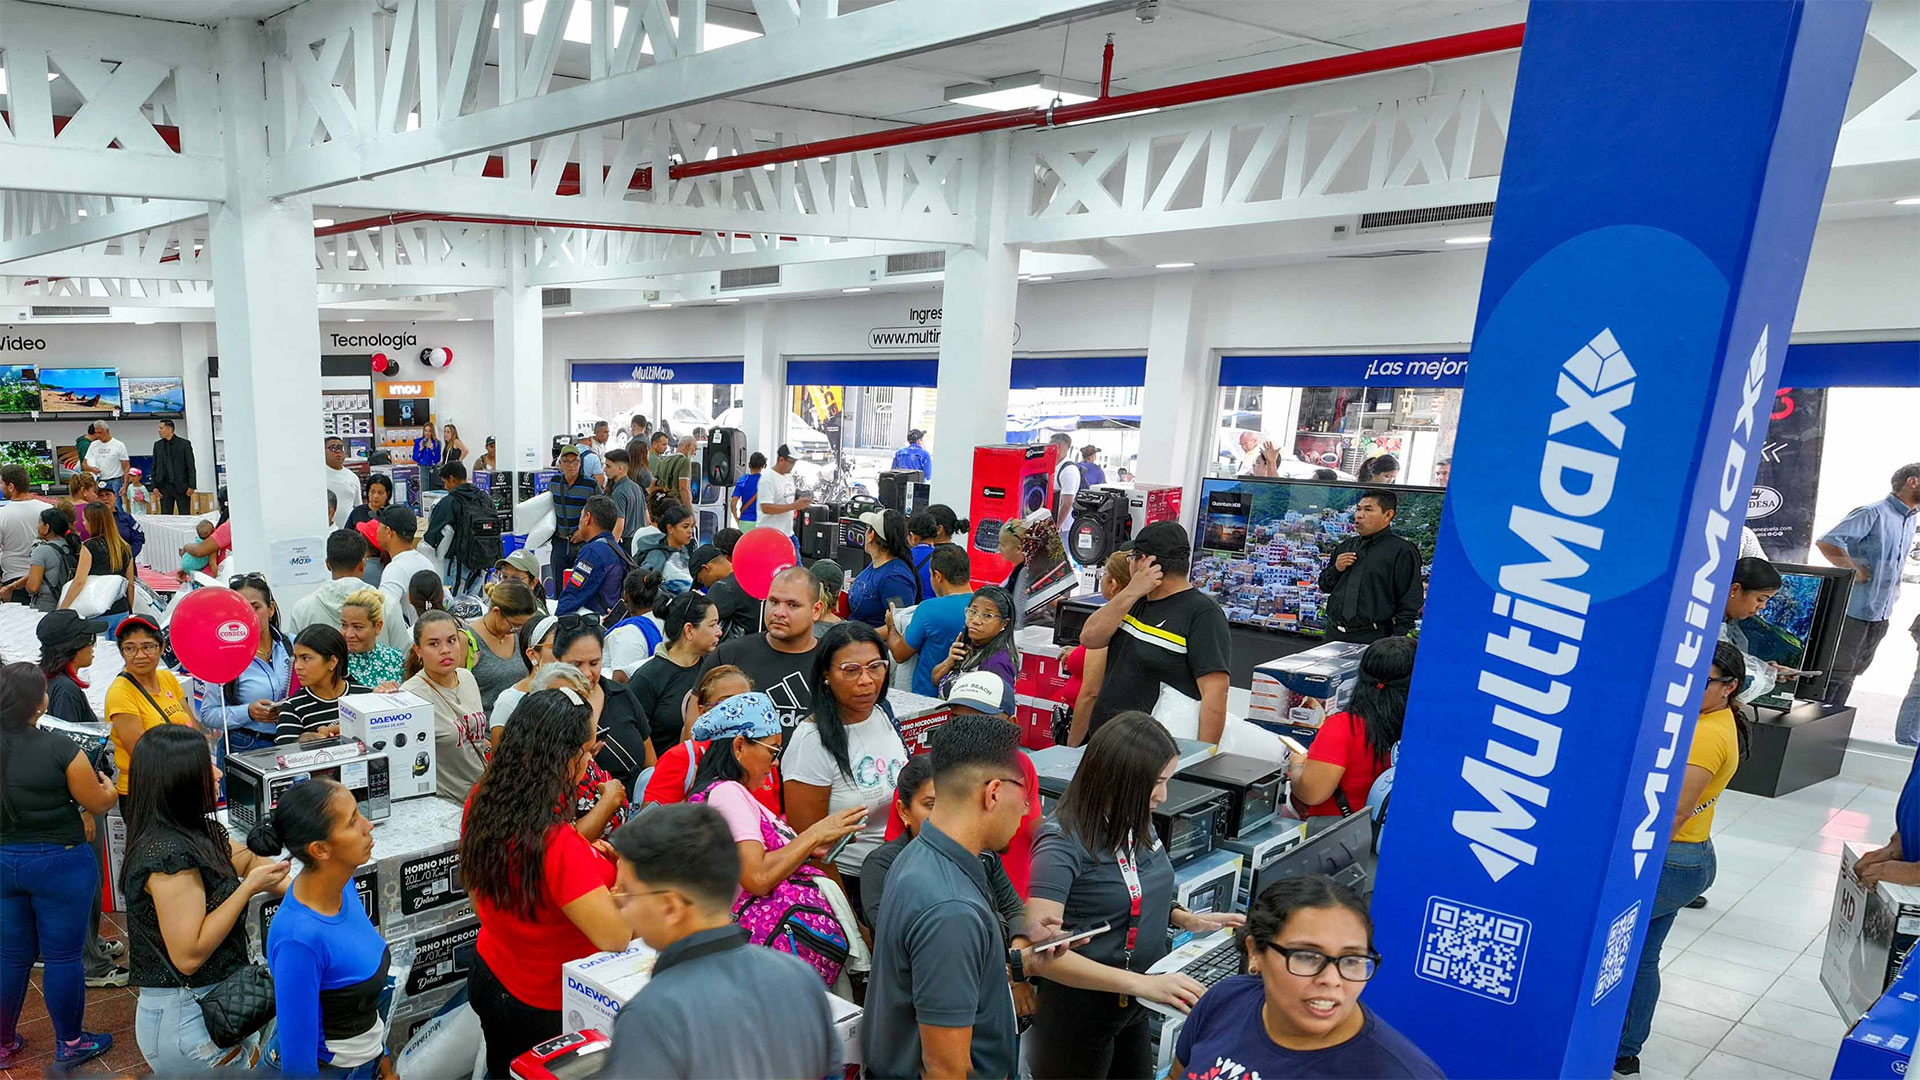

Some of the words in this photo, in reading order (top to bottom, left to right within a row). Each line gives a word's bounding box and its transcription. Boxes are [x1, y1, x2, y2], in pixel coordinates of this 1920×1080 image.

[330, 331, 417, 350] Tecnología
[632, 366, 675, 380] MultiMax
[1405, 357, 1469, 380] mejor
[1631, 361, 1765, 852] MultiMax
[1452, 371, 1637, 867] MultiMax
[970, 683, 993, 696] BEACH
[370, 713, 412, 724] DAEWOO
[914, 714, 949, 728] MICROONDAS
[404, 860, 438, 876] HORNO
[1840, 888, 1856, 922] HD
[568, 977, 620, 1012] DAEWOO
[407, 1019, 442, 1054] MultiMax
